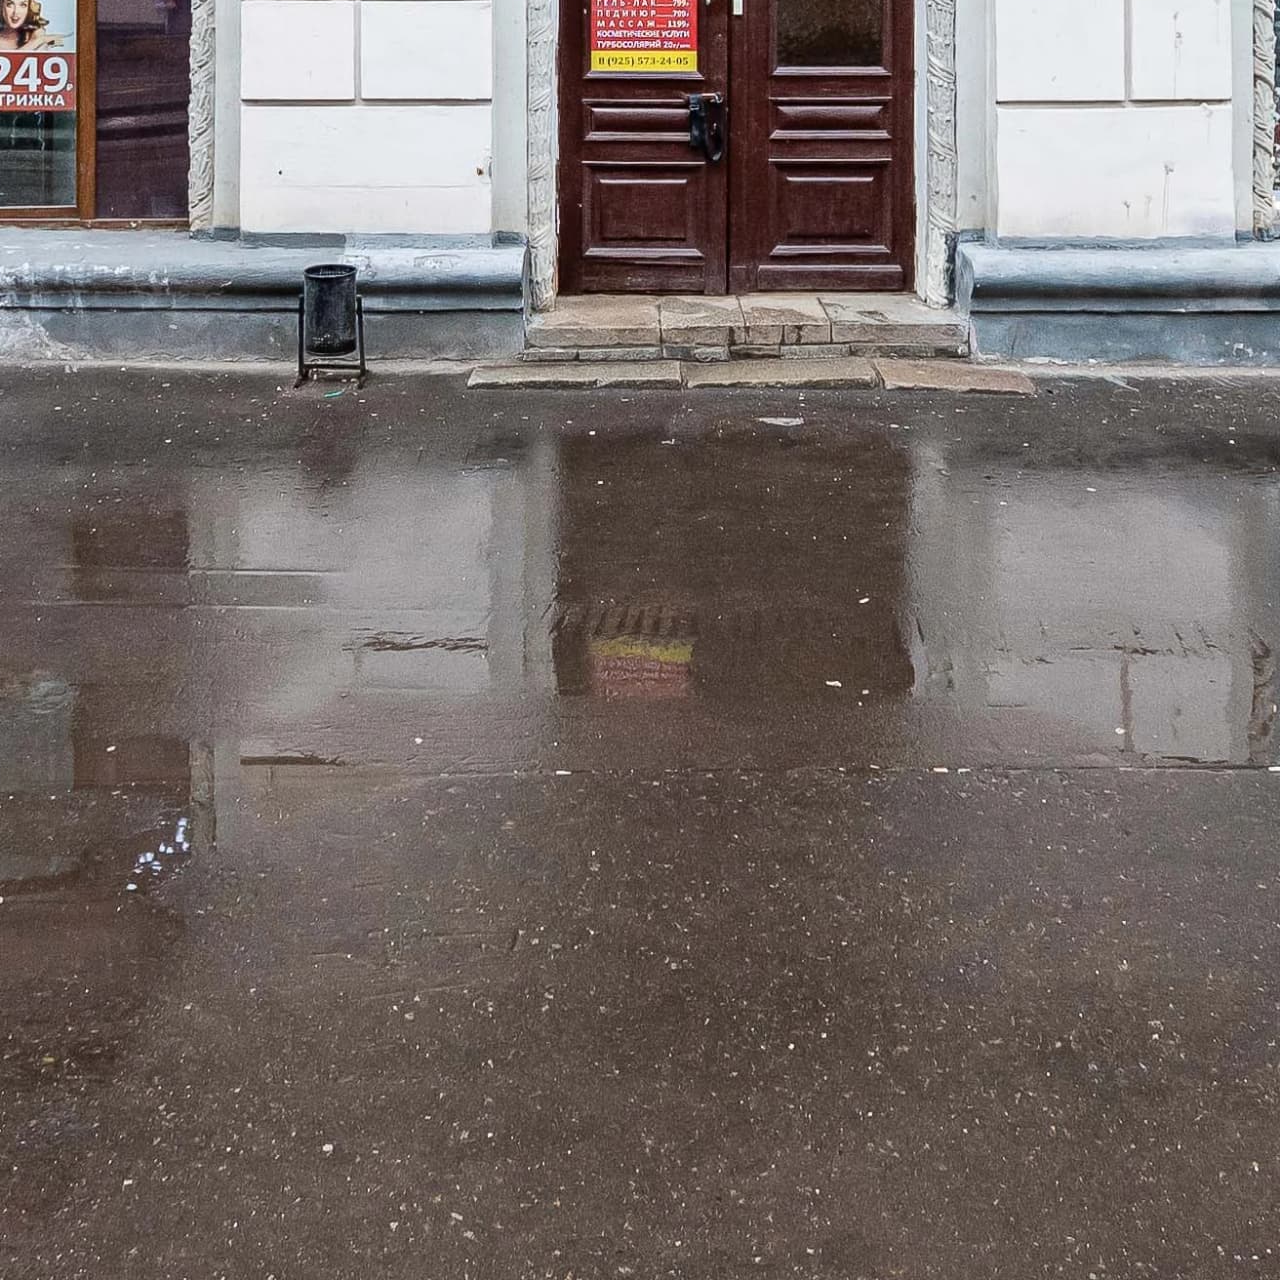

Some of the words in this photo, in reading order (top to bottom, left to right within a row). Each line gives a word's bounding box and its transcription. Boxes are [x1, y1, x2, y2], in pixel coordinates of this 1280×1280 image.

[597, 10, 657, 19] ПЕДИКЮР
[597, 20, 656, 29] МАССАЖ
[607, 56, 635, 67] (925)
[637, 56, 690, 66] 573-24-05
